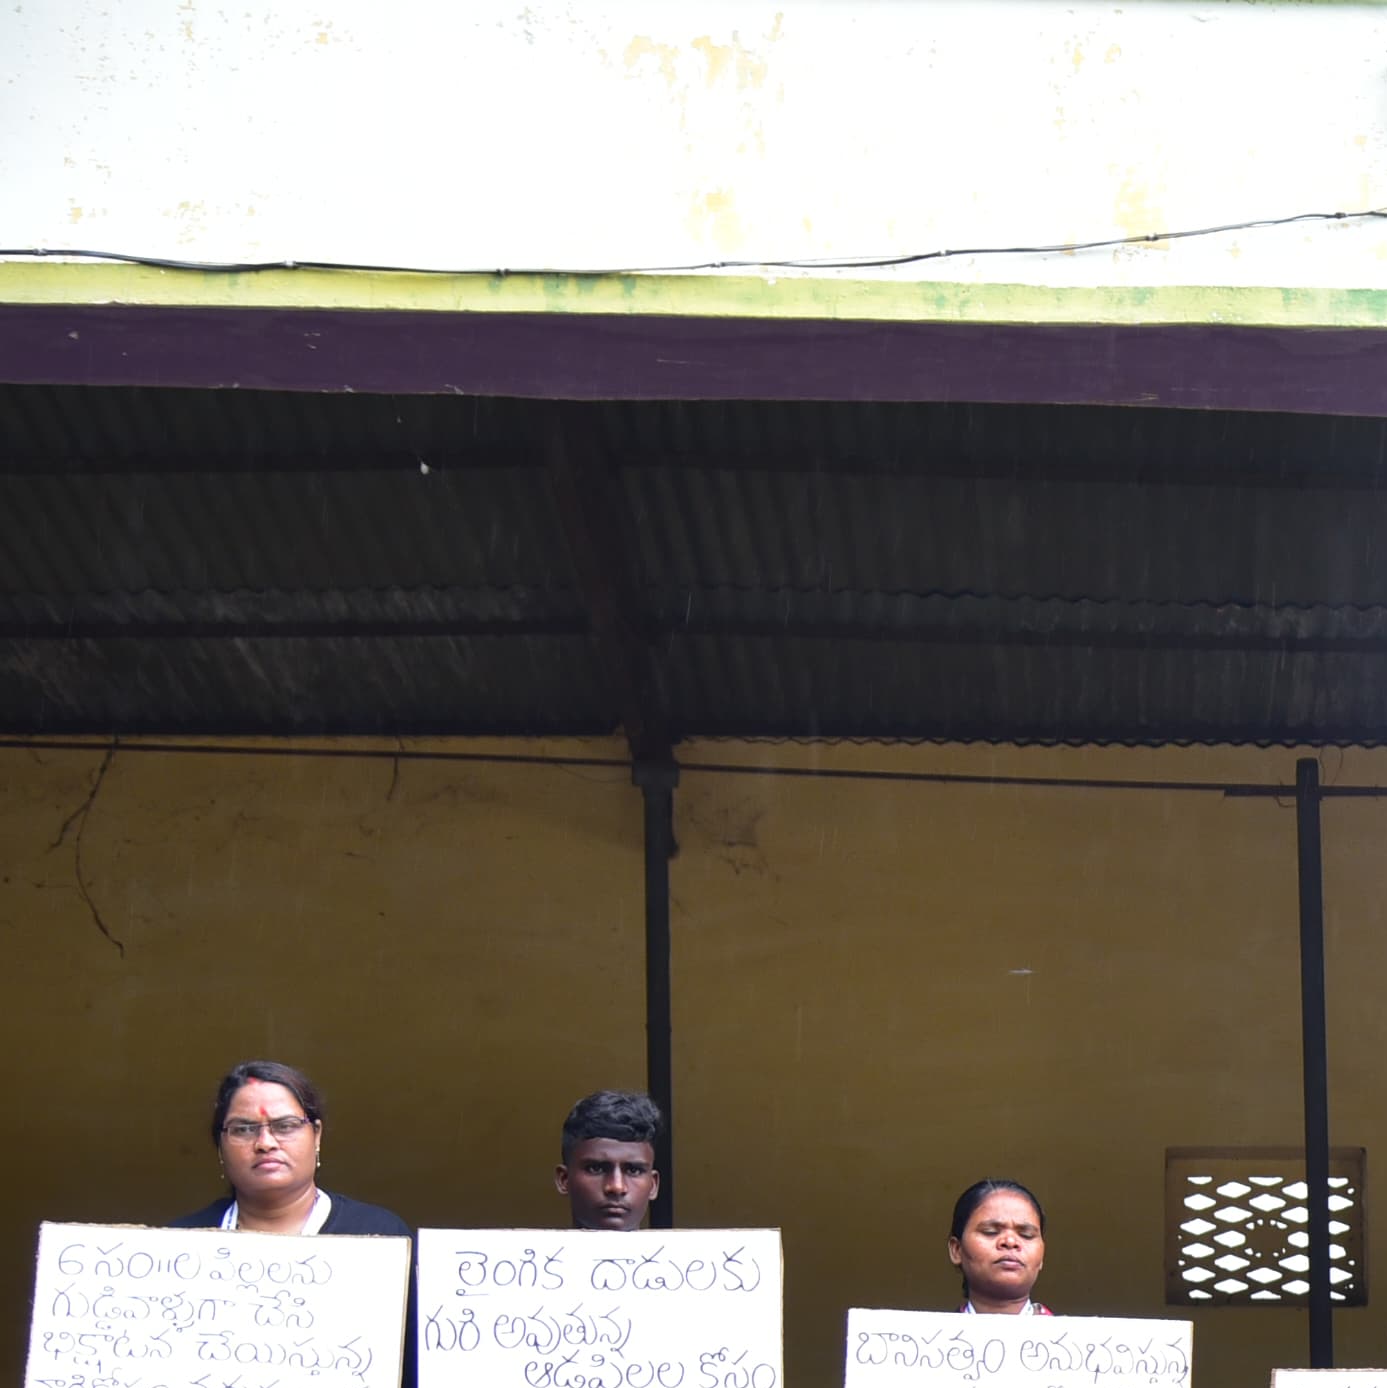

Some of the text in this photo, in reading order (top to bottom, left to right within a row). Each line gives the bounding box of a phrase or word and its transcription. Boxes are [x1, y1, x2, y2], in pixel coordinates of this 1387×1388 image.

[210, 1248, 332, 1292] పిల్లలను
[456, 1245, 760, 1297] లైంగిక దాడులకు
[249, 1291, 314, 1328] చేసి
[426, 1305, 480, 1351] గురి
[856, 1329, 1005, 1380] బానిసత్వం
